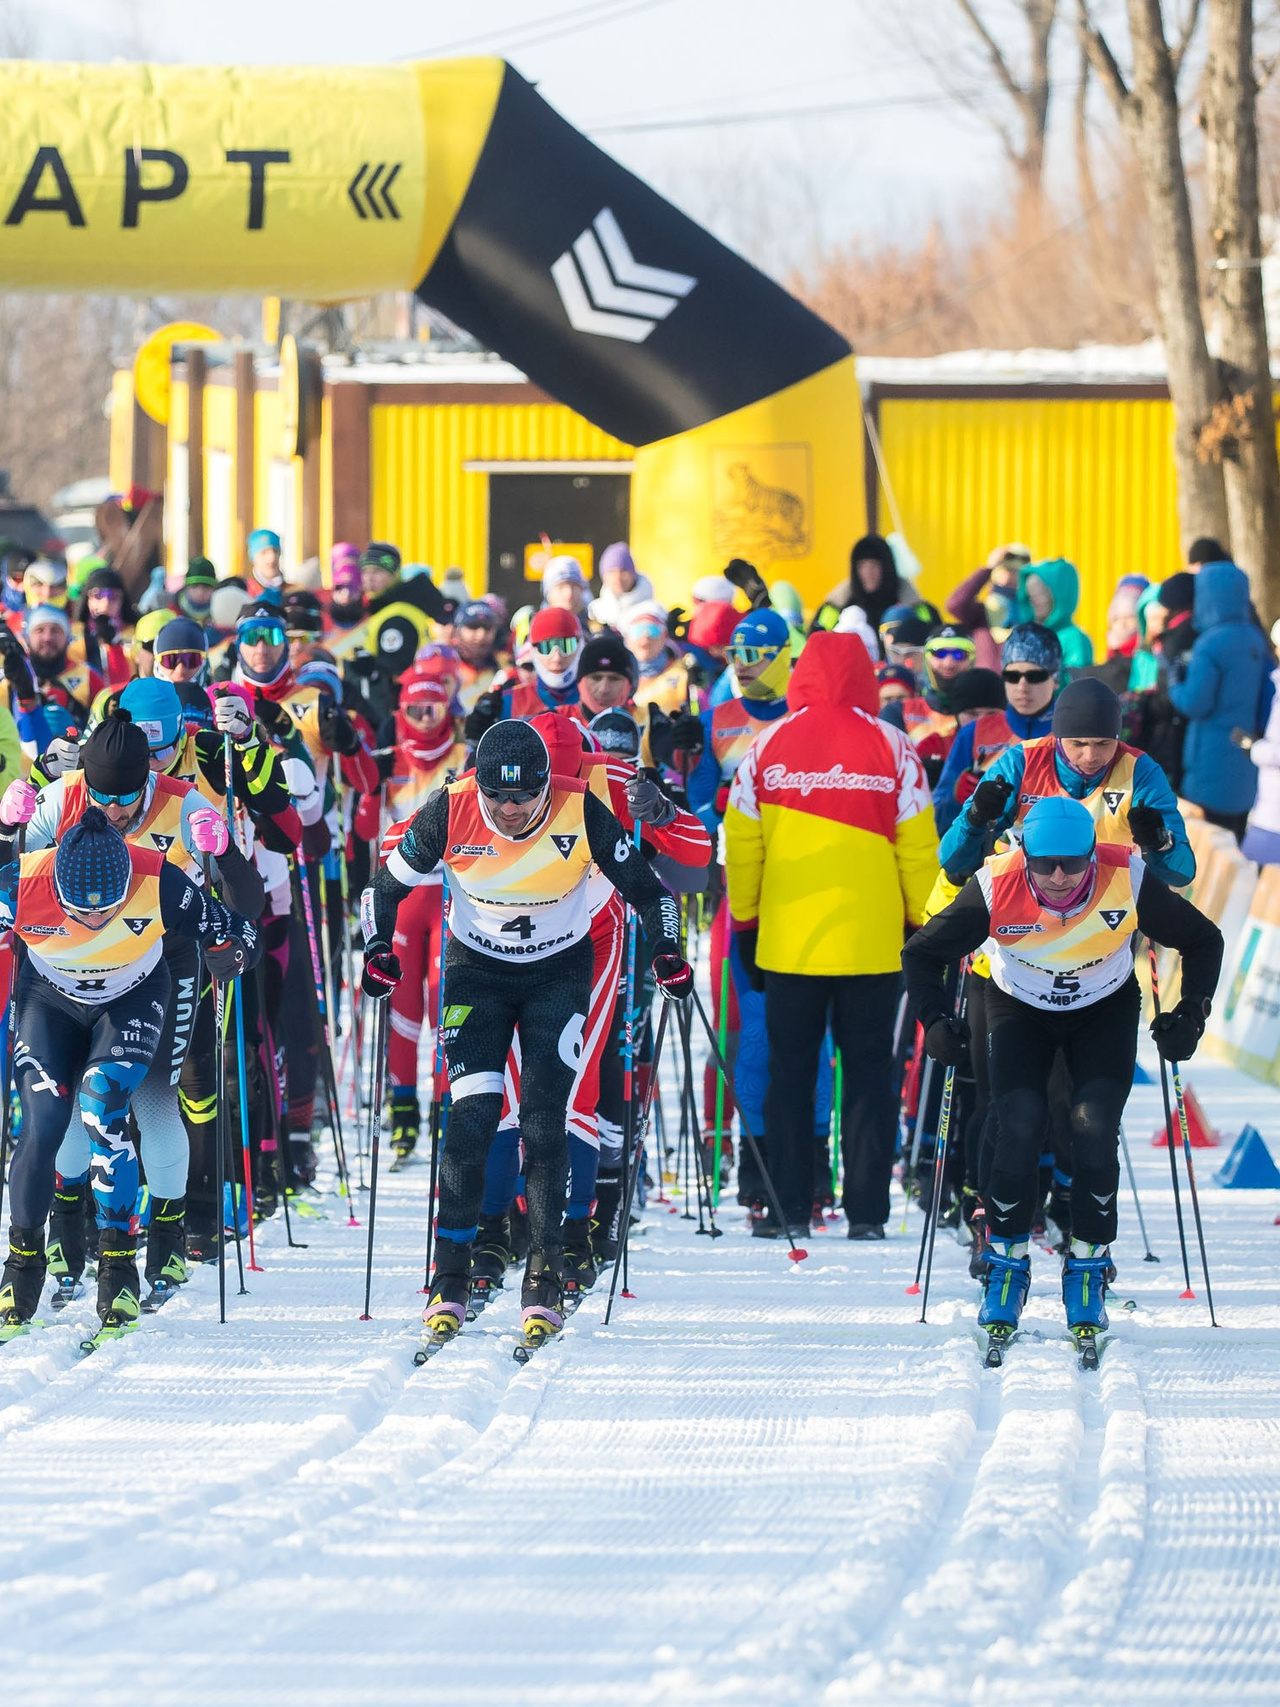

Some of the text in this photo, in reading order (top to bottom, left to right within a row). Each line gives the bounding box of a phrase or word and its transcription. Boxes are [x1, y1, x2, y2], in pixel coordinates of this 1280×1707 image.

[762, 763, 896, 797] Владивосток
[1109, 794, 1117, 807] 3
[158, 836, 168, 850] 3
[560, 837, 570, 851] 3
[1108, 911, 1119, 925] 3
[133, 920, 143, 931] 3
[500, 915, 536, 940] 4
[1051, 976, 1082, 995] 5
[170, 976, 195, 1087] BIVIUM
